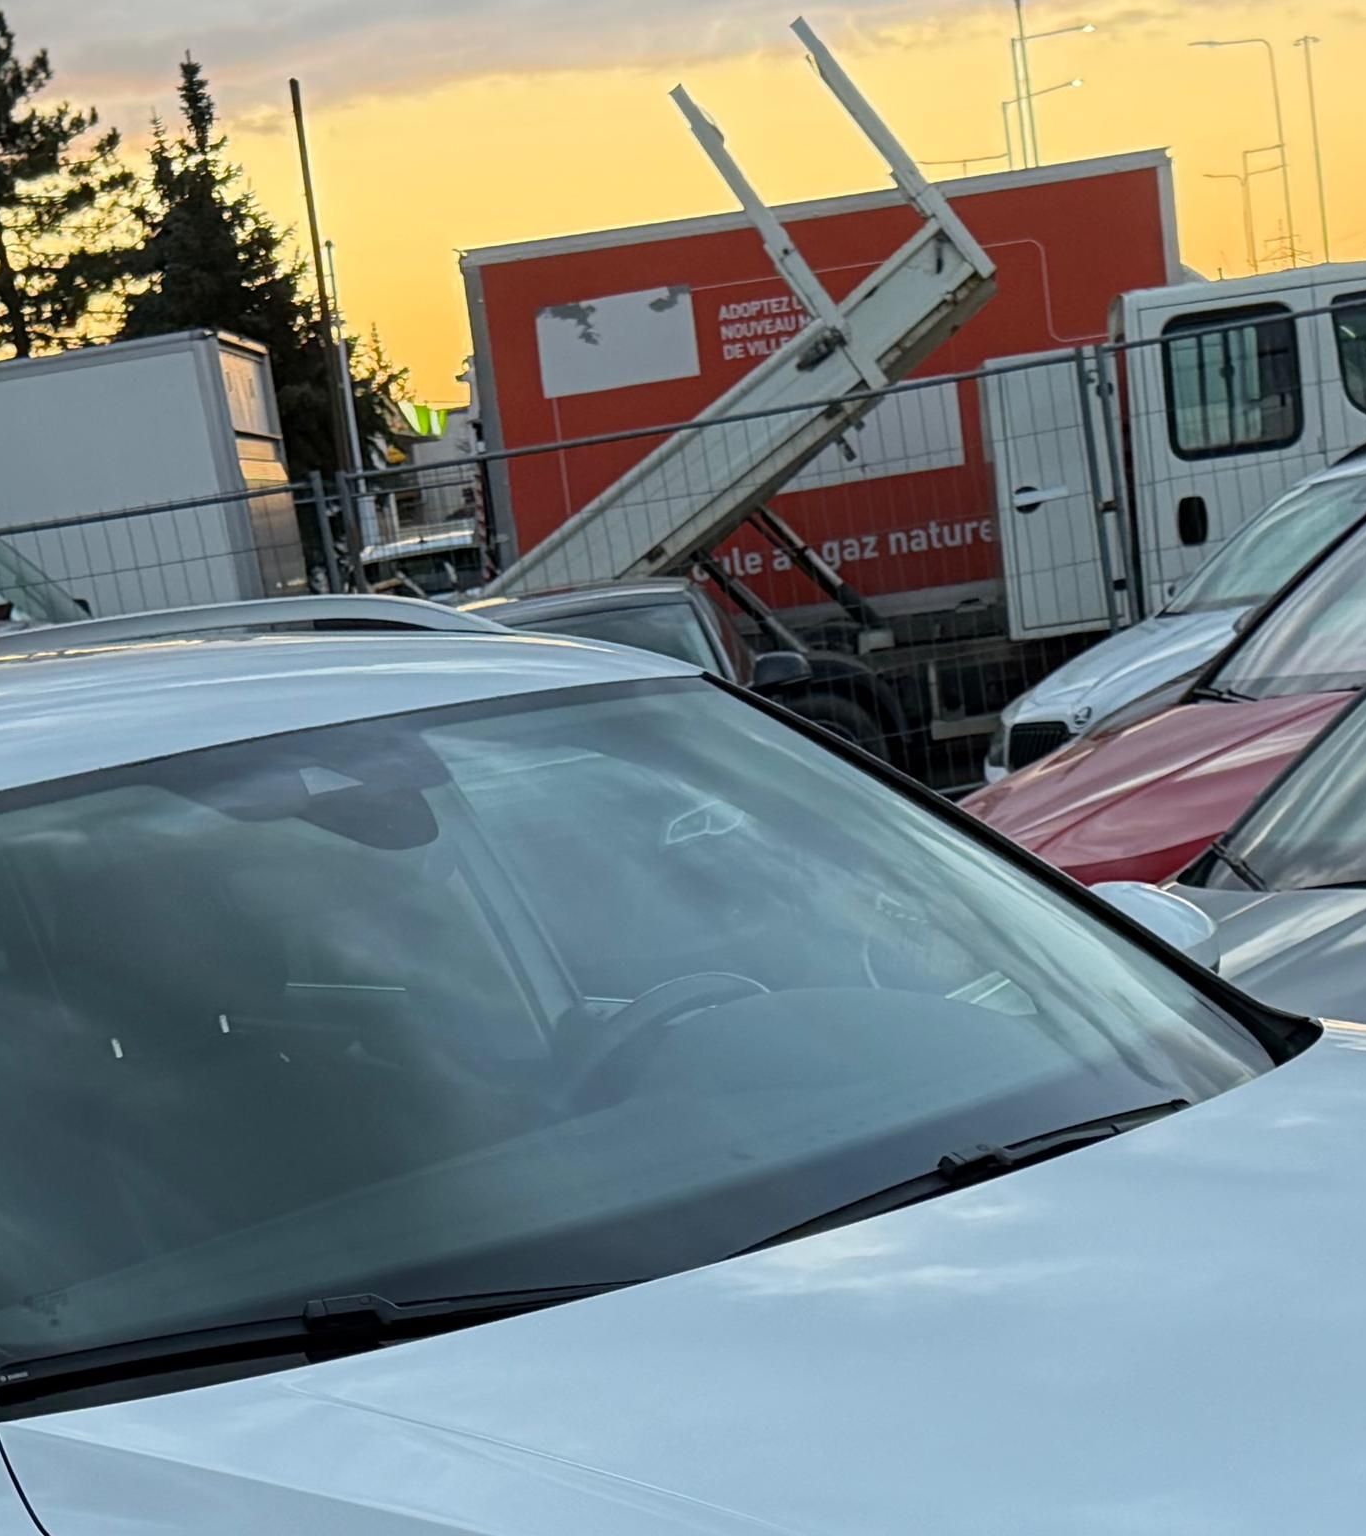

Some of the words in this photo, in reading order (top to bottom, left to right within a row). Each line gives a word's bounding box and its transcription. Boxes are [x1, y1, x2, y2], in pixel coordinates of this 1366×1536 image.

[719, 297, 790, 321] ADOPTEZ
[720, 314, 796, 340] NOUVEAU
[722, 343, 747, 361] DE
[821, 534, 880, 571] gaz
